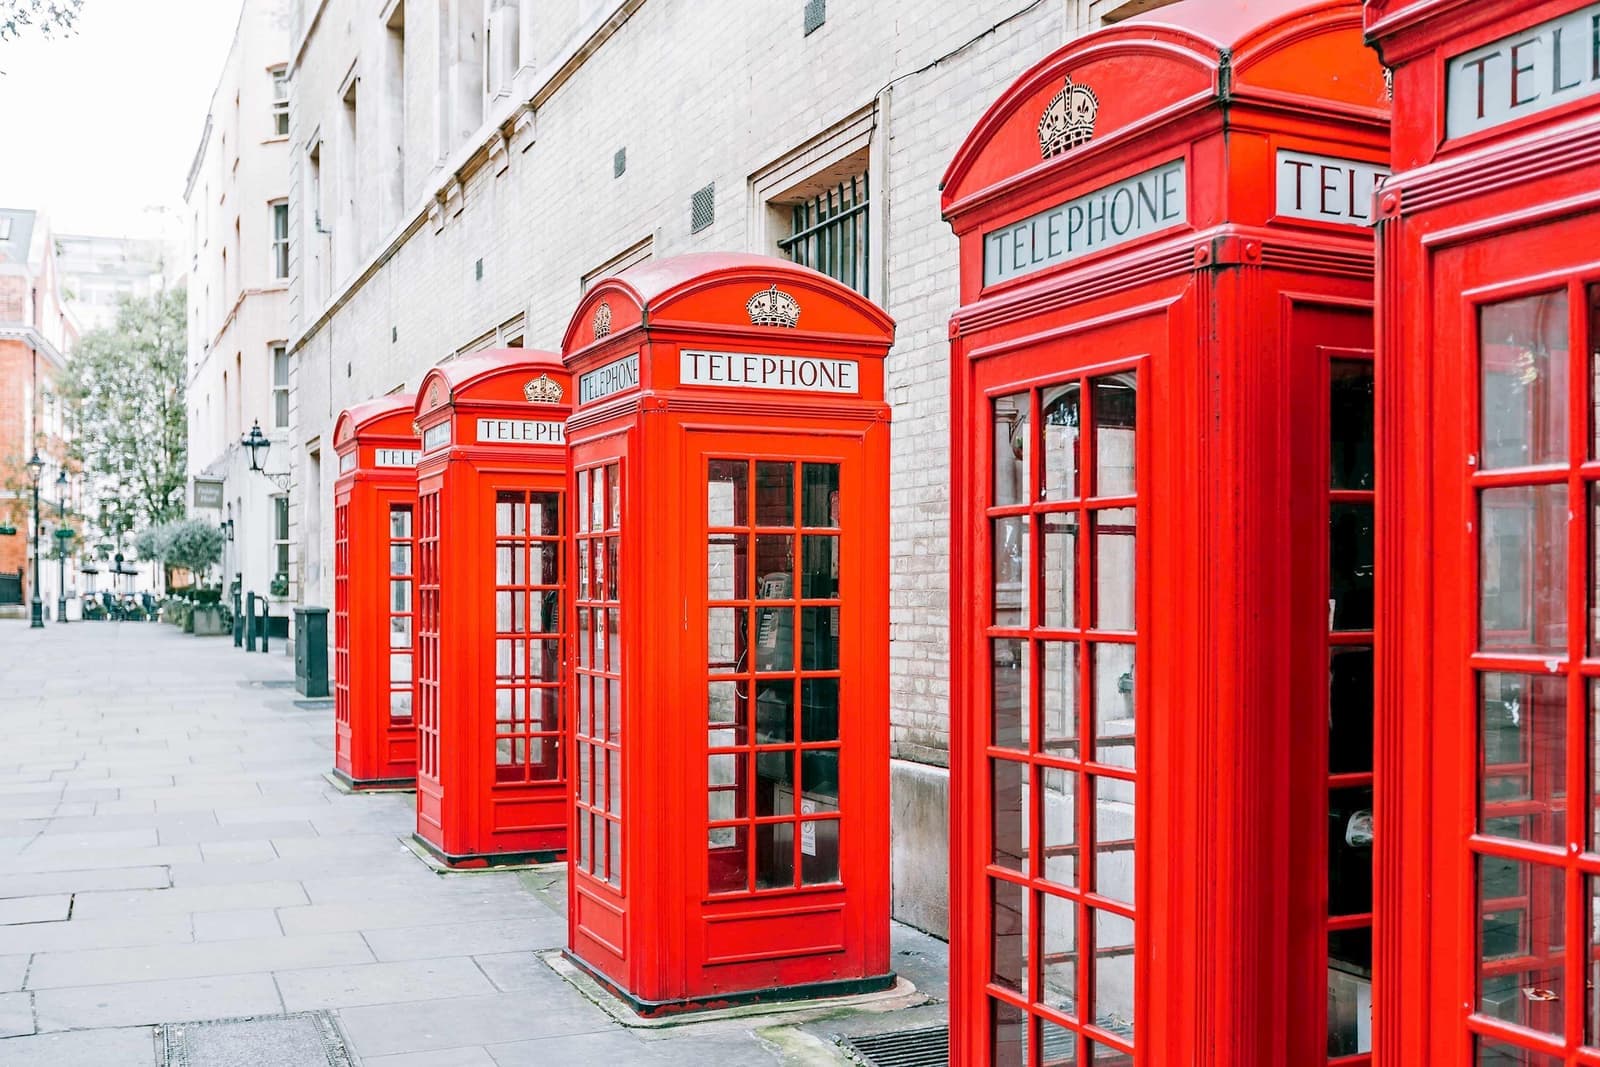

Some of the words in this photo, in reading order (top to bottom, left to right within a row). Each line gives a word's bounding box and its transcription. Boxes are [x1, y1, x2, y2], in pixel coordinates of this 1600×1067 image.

[1462, 14, 1600, 119] TEL
[1284, 160, 1390, 219] TEL
[992, 167, 1181, 276] TELEPHONE
[583, 358, 638, 402] TELEPHONE
[687, 353, 852, 389] TELEPHONE
[482, 420, 561, 441] TELEPH
